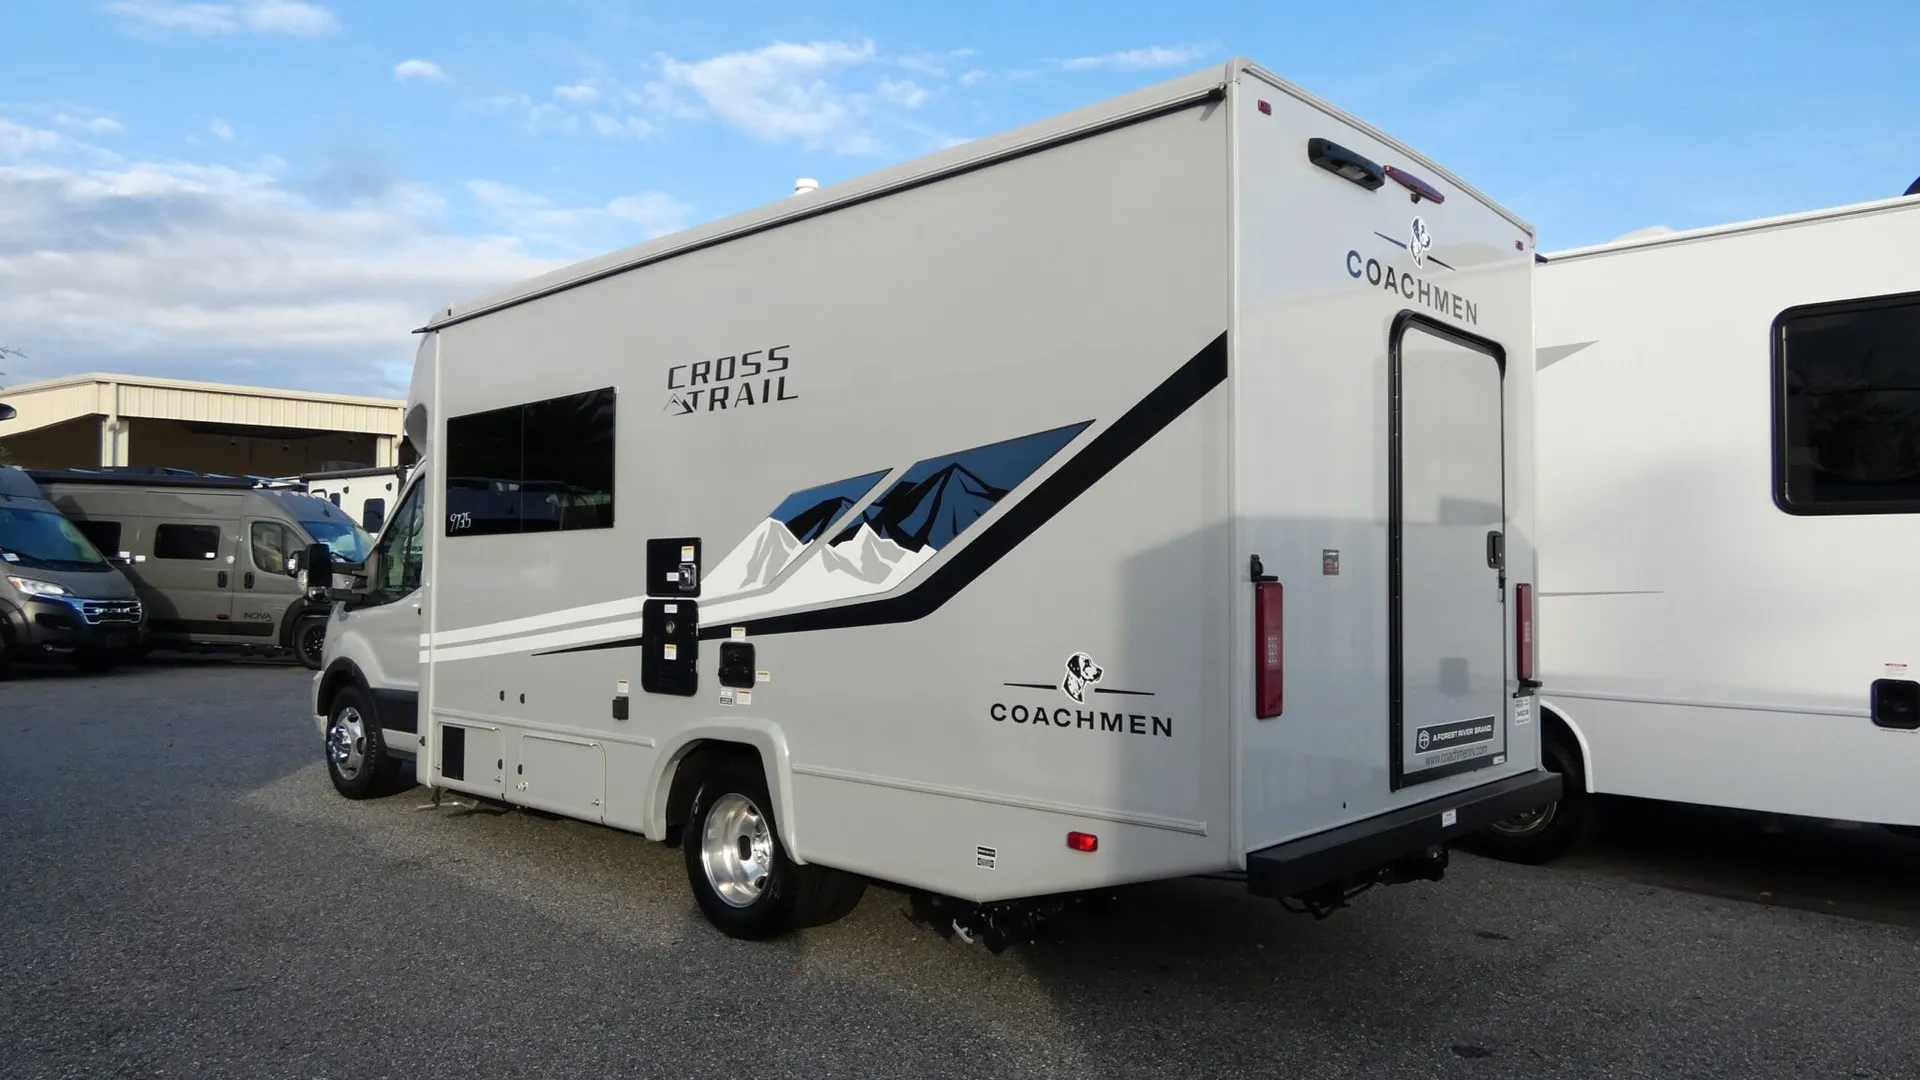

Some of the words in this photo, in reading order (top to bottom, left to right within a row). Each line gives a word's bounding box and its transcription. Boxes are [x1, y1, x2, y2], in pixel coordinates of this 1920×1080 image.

[1346, 250, 1477, 325] COACHMEN
[667, 344, 790, 390] CROSS
[686, 376, 799, 412] TRAIL
[450, 511, 471, 532] 9735
[990, 703, 1172, 737] COACHMEN
[1432, 734, 1438, 742] A
[1437, 730, 1458, 741] FOREST
[1458, 728, 1473, 737] RIVER
[1474, 724, 1492, 734] BRAND
